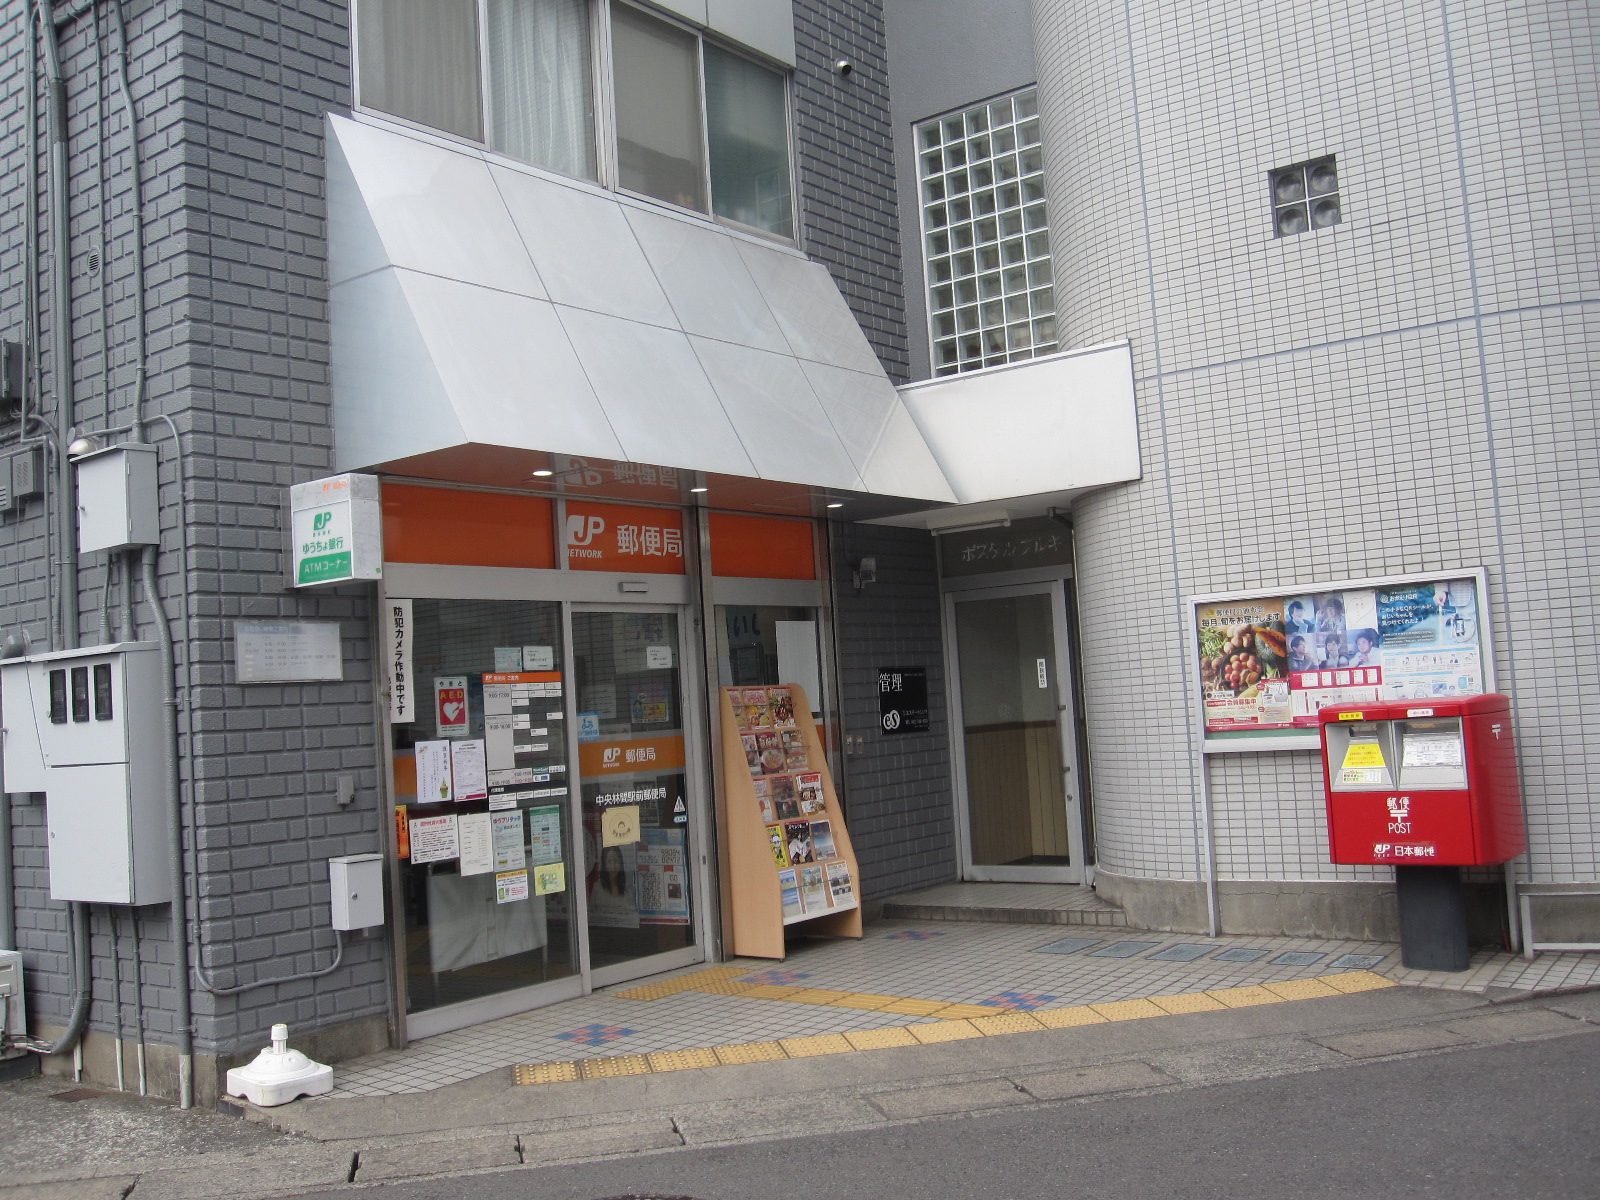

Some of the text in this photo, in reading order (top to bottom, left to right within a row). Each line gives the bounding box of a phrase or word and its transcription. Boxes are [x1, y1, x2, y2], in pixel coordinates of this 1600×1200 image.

[313, 511, 332, 531] JP
[567, 515, 683, 557] JP 郵便局
[302, 537, 344, 555] ゆうちょ銀行
[568, 548, 603, 558] ETWORK
[304, 559, 348, 574] ATMコーナー
[393, 606, 406, 716] 防犯カメラ作動中です
[439, 680, 463, 688] やまと
[879, 673, 903, 692] 管理
[440, 691, 464, 700] AED
[603, 747, 656, 763] JP 郵便局
[595, 787, 667, 806] 中央林間駅前郵便局
[1386, 796, 1411, 811] 郵便
[1388, 822, 1412, 834] POST
[1394, 846, 1435, 857] 日本郵便
